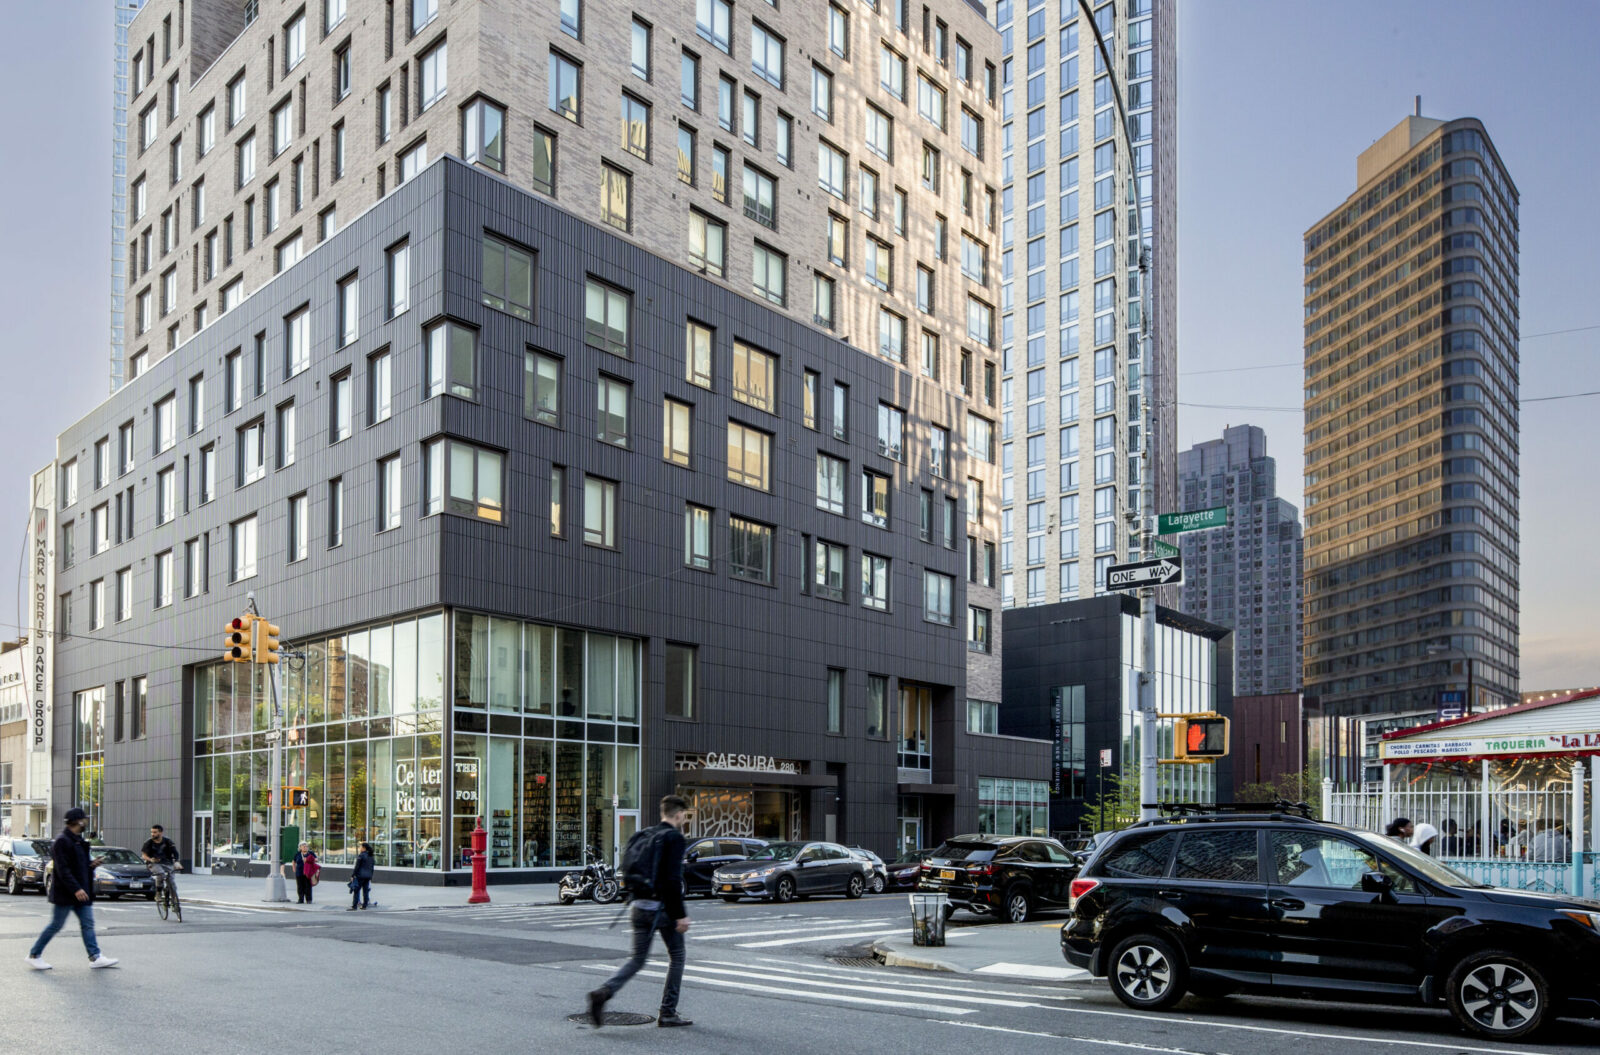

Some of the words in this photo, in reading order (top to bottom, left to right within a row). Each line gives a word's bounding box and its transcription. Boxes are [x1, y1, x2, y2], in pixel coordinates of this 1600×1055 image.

[1168, 511, 1214, 525] Lafayette
[36, 539, 46, 576] MARK
[1112, 570, 1136, 583] ONE
[1149, 565, 1173, 578] WAY
[36, 584, 45, 639] MORRIS
[35, 646, 45, 692] DANCE
[35, 700, 45, 746] GROUP
[1485, 739, 1546, 751] TAQUERIA
[455, 763, 478, 773] THE
[706, 752, 776, 771] CAESURA
[780, 763, 795, 773] 280
[395, 790, 442, 813] Ficion
[455, 791, 479, 801] FOR
